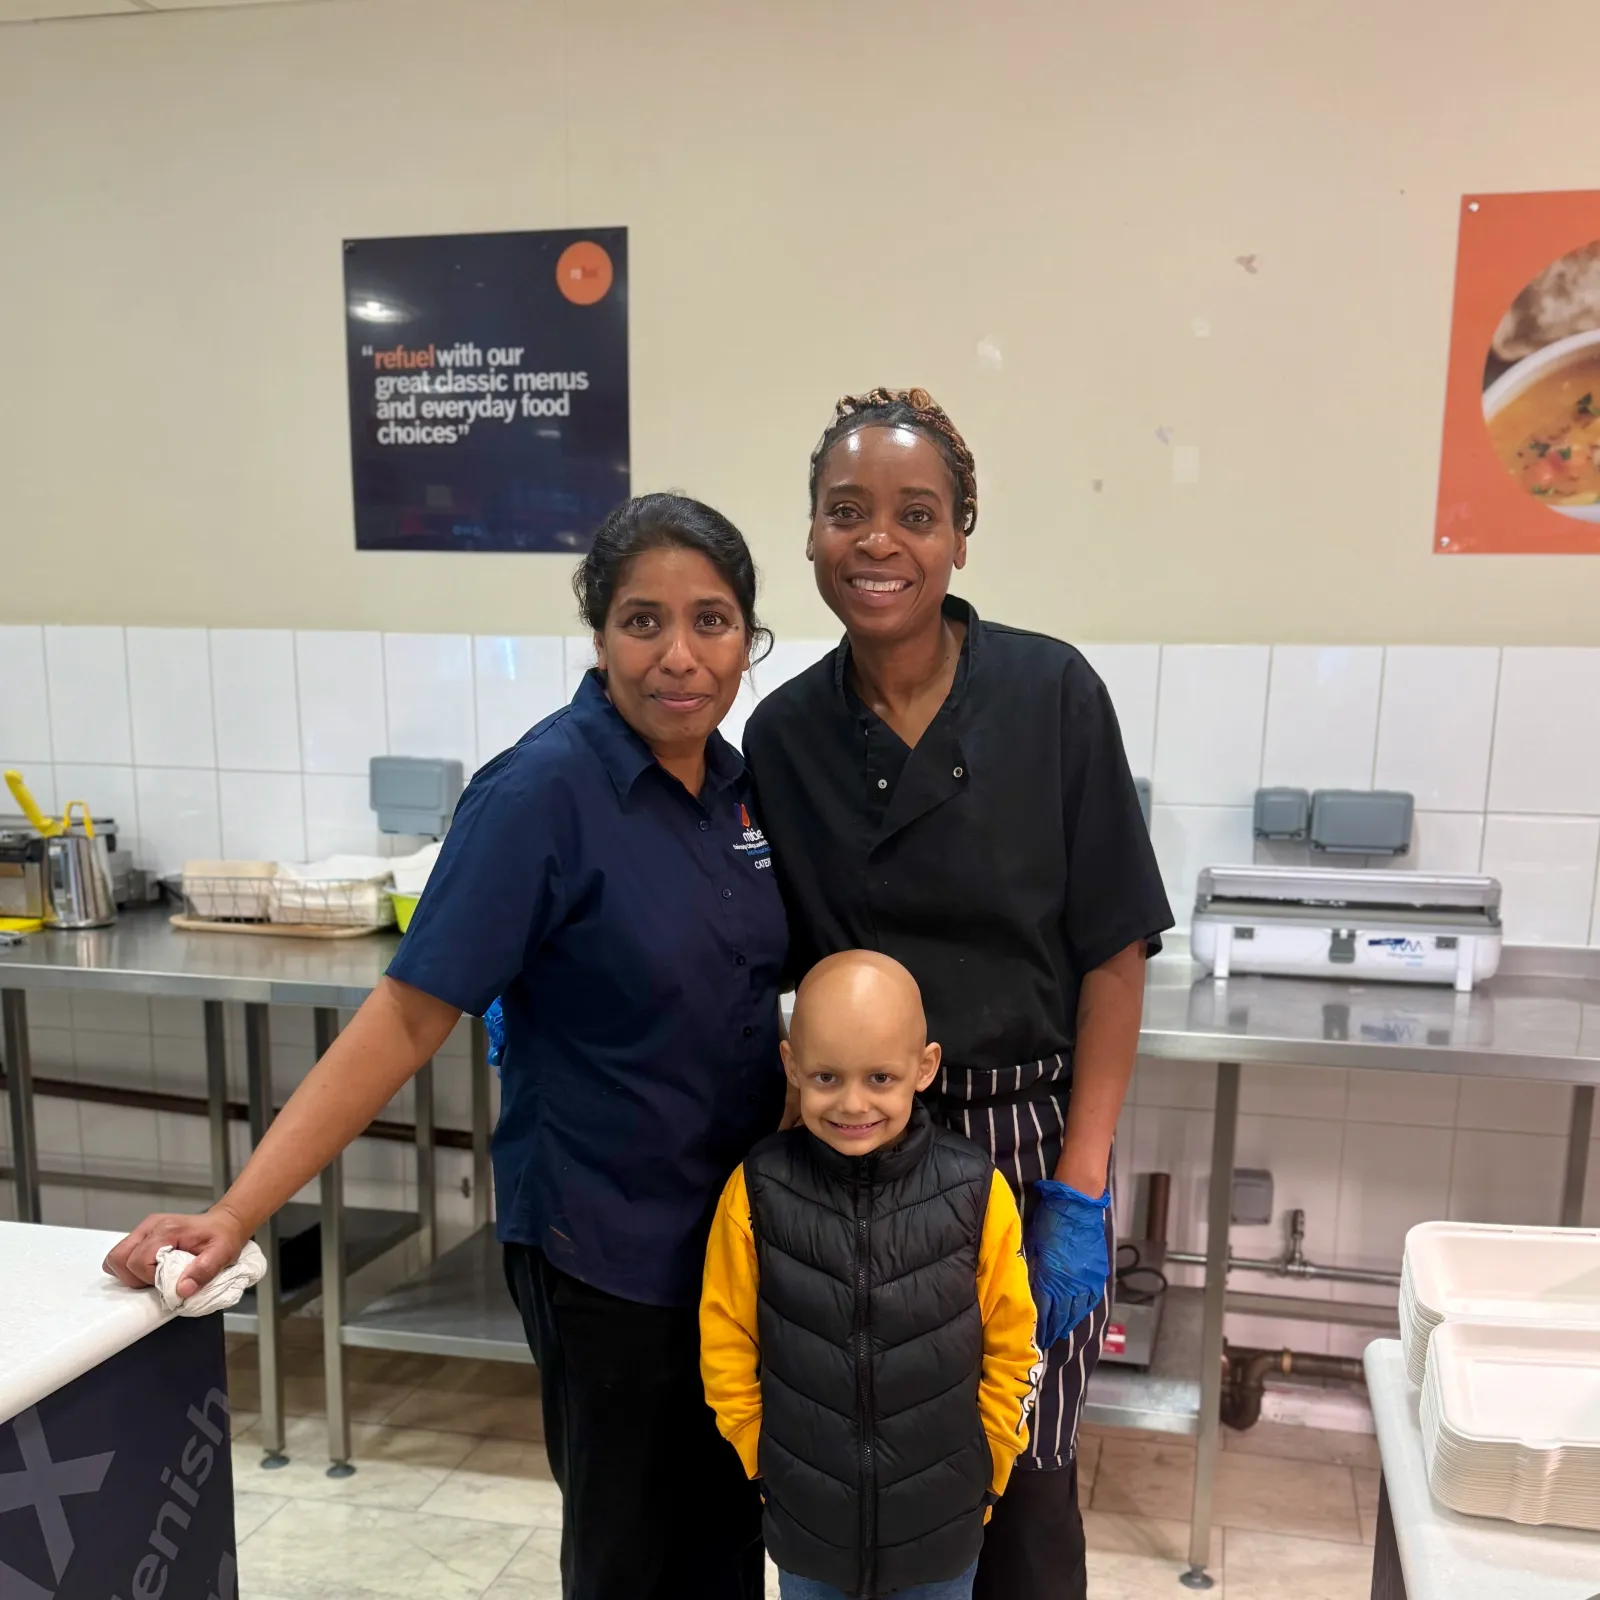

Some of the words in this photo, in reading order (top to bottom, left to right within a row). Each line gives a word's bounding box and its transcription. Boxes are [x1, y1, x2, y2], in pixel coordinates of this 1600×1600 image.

[436, 342, 482, 367] with
[487, 347, 525, 366] our
[375, 371, 430, 400] great
[434, 368, 509, 393] classic
[514, 371, 589, 391] menus
[376, 395, 416, 419] and
[421, 394, 516, 423] everyday
[521, 392, 570, 417] food
[111, 1387, 230, 1600] enish
